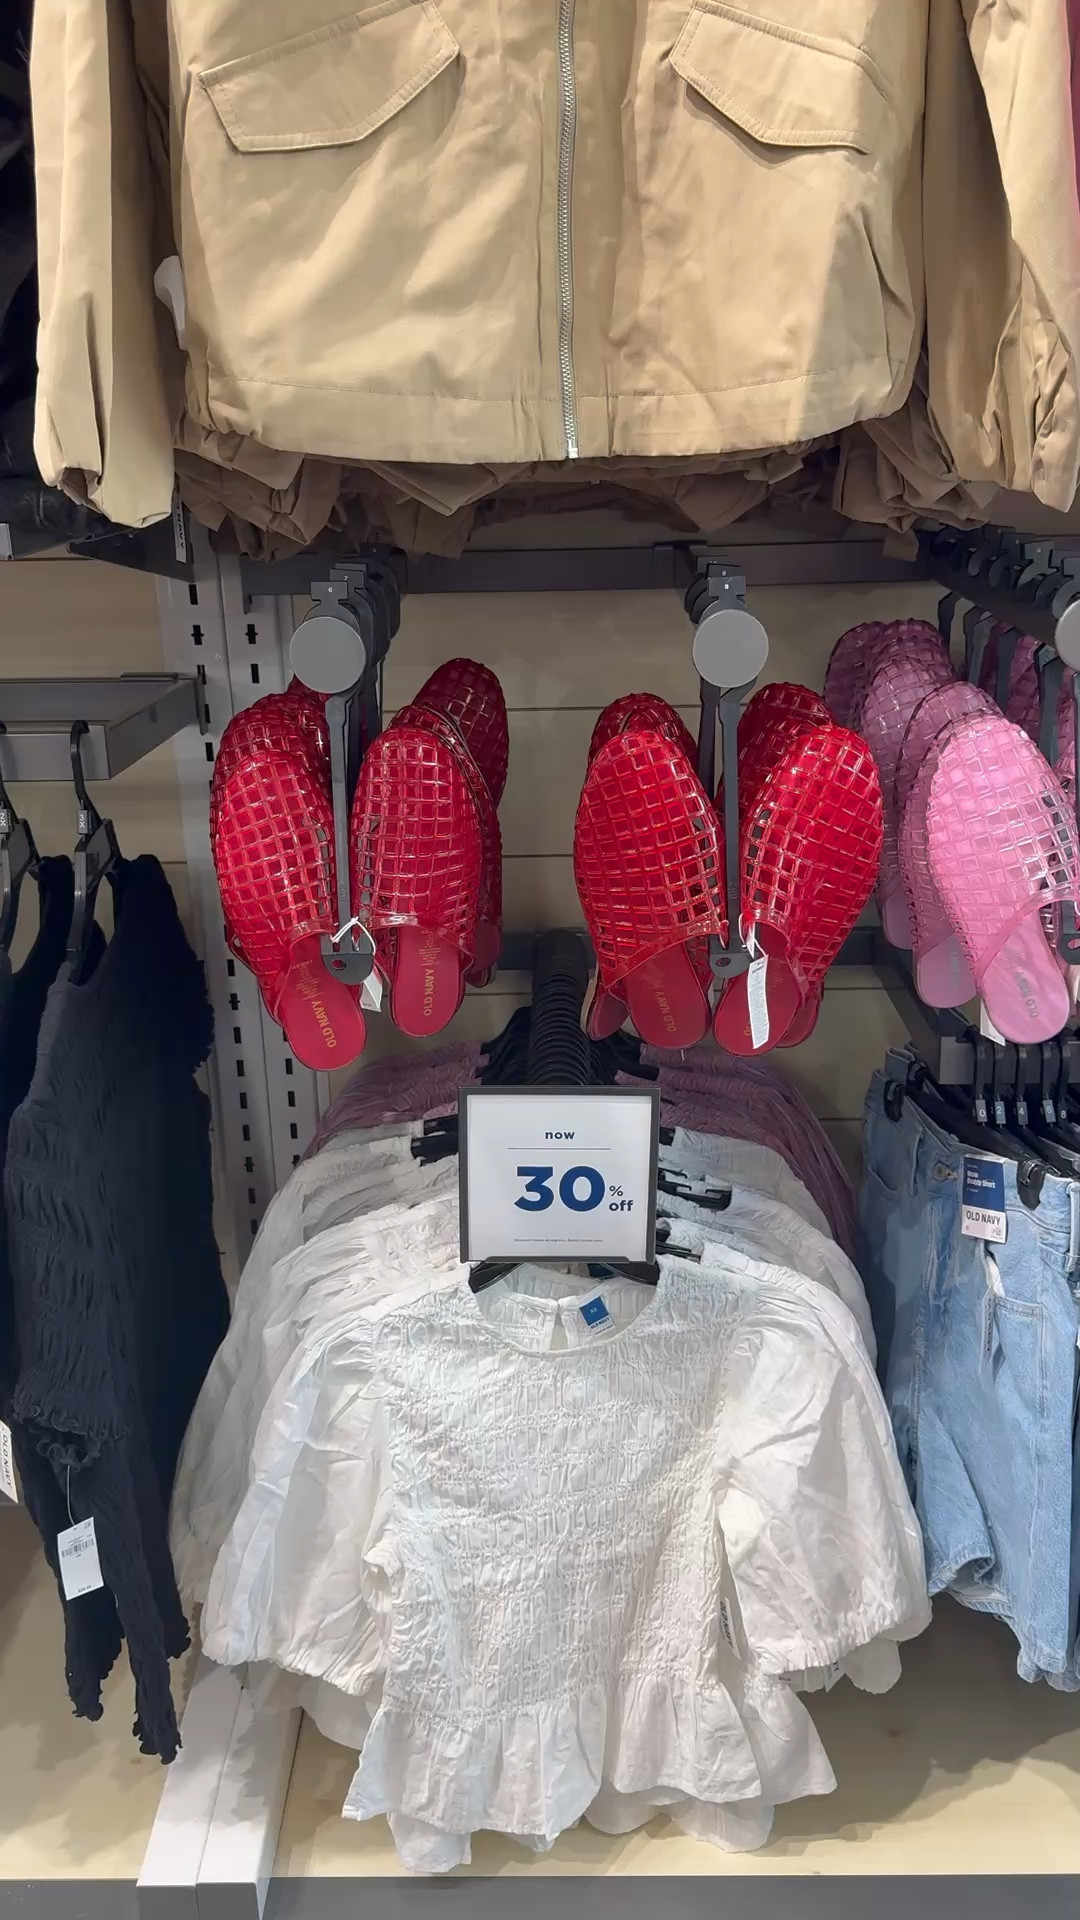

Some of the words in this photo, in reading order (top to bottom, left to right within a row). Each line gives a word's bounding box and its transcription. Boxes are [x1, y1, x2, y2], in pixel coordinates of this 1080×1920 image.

[423, 969, 435, 994] NAVY
[423, 996, 433, 1016] OLD
[655, 991, 671, 1014] NAVY
[1025, 998, 1040, 1018] OLD
[311, 1000, 329, 1028] NAVY
[663, 1015, 677, 1032] OLD
[322, 1023, 337, 1048] OLD
[996, 1106, 1002, 1114] 2
[1018, 1107, 1025, 1115] 4
[1046, 1105, 1052, 1114] 6
[1060, 1110, 1067, 1119] 8
[545, 1130, 576, 1140] now
[514, 1165, 606, 1212] 30
[608, 1199, 634, 1212] off
[966, 1210, 980, 1222] OLD
[981, 1213, 1001, 1226] NAVY
[3, 1457, 12, 1488] NAVY
